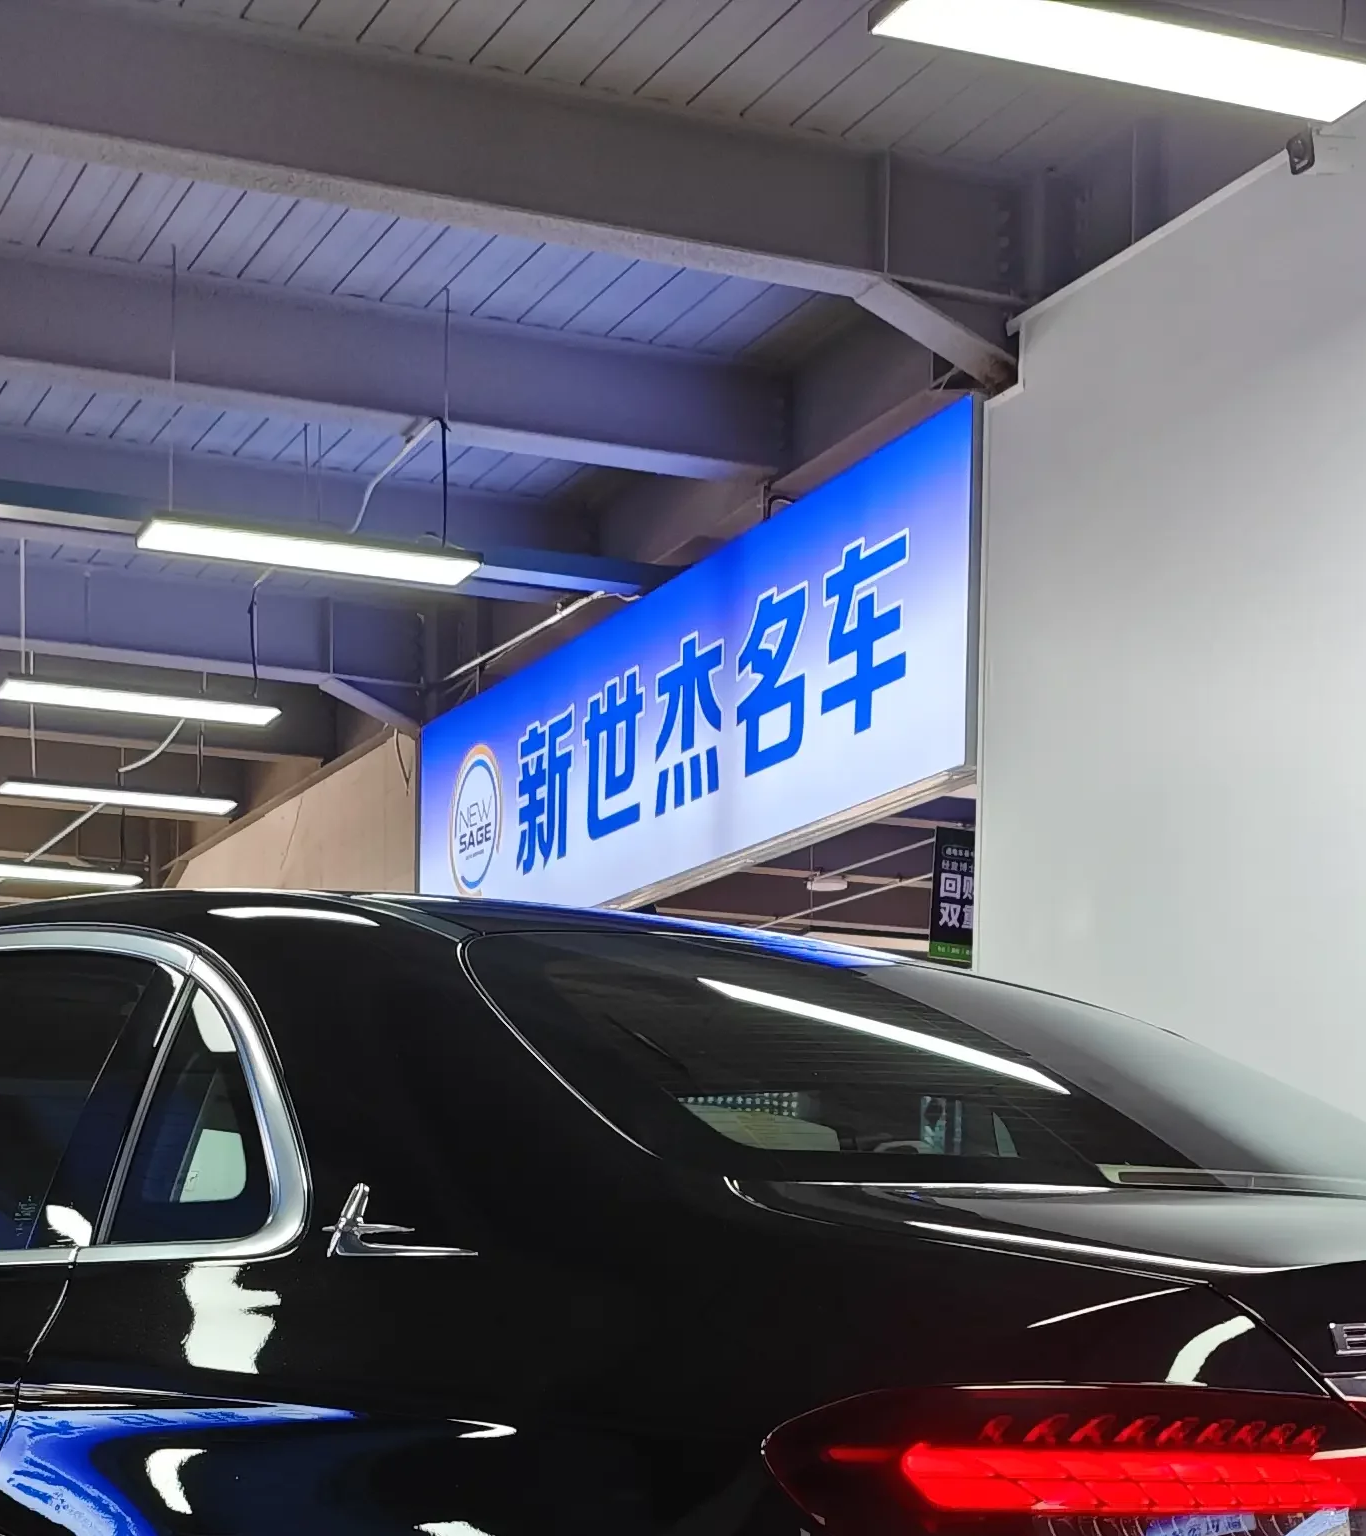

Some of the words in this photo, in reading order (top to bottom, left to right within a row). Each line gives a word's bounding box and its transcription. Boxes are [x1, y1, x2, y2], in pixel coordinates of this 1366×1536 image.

[516, 528, 910, 875] 新世杰名车
[459, 794, 492, 832] NEW
[459, 822, 492, 854] SAGE
